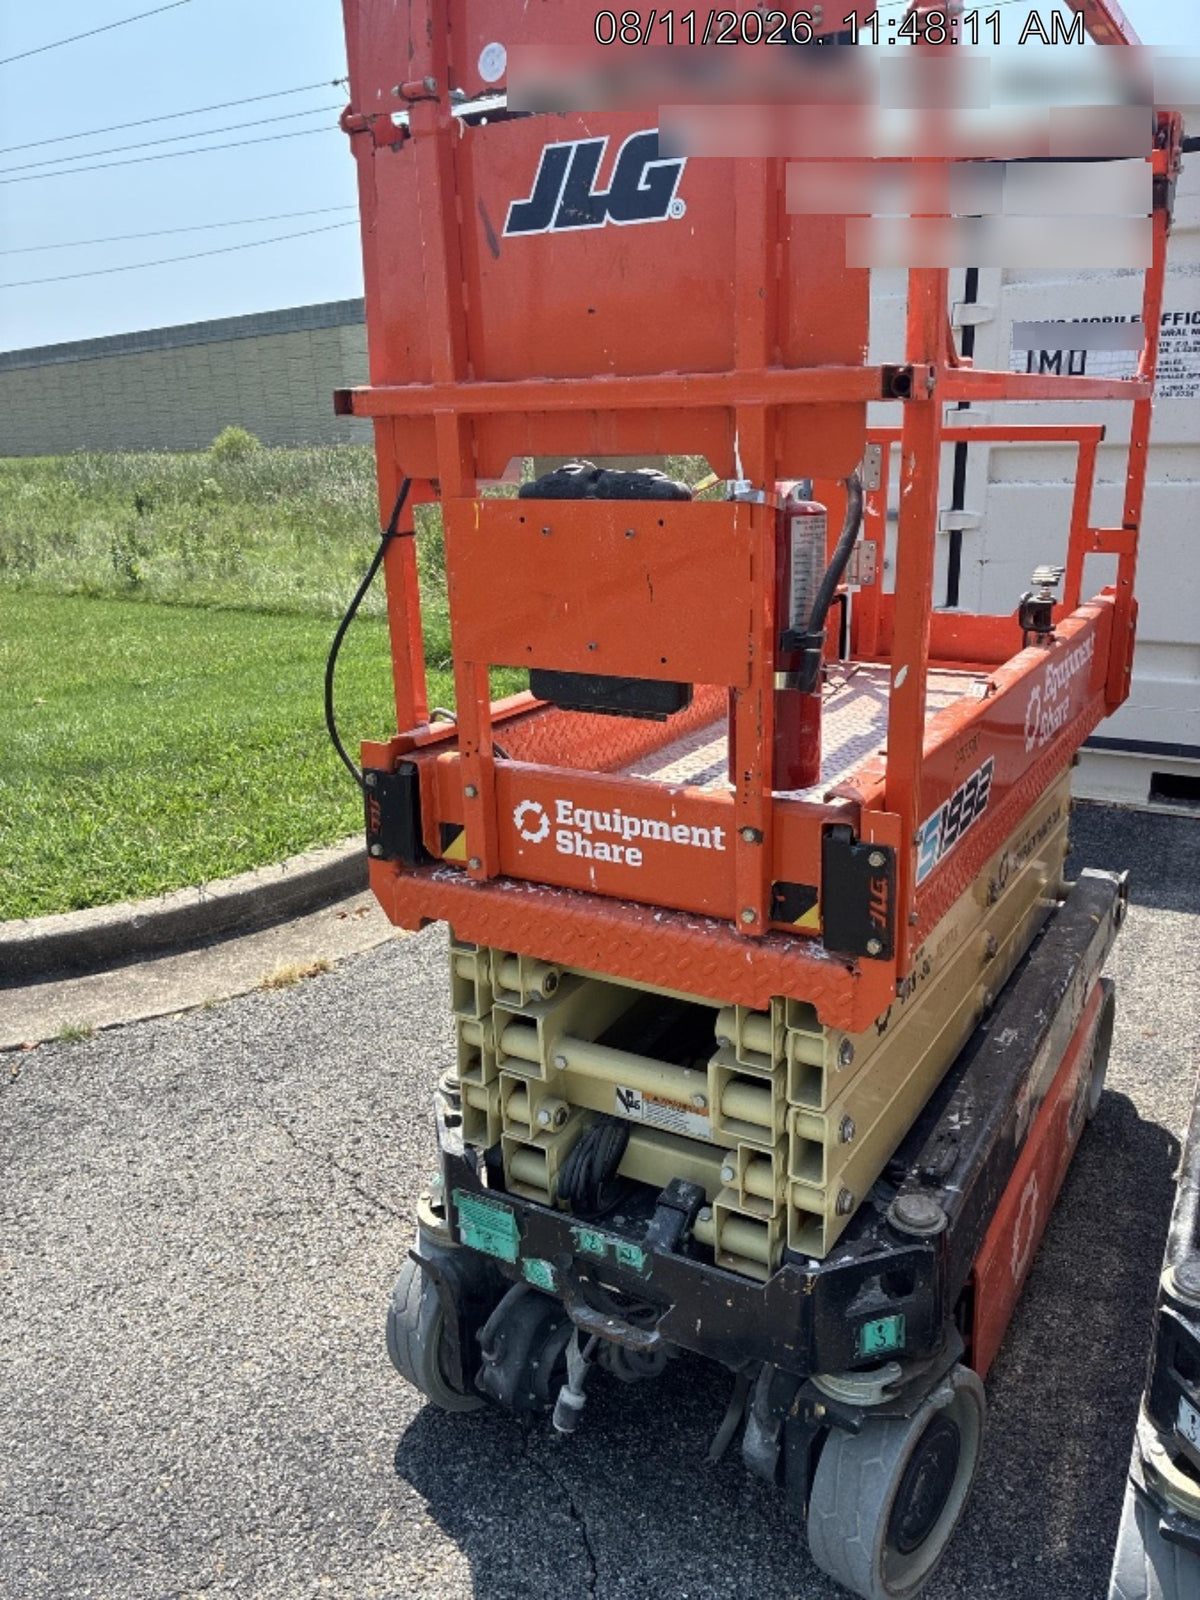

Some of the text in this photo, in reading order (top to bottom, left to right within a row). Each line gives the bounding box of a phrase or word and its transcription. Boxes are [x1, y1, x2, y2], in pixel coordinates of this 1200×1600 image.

[555, 799, 727, 852] Equipment
[556, 829, 644, 868] Share
[868, 875, 889, 929] JLG
